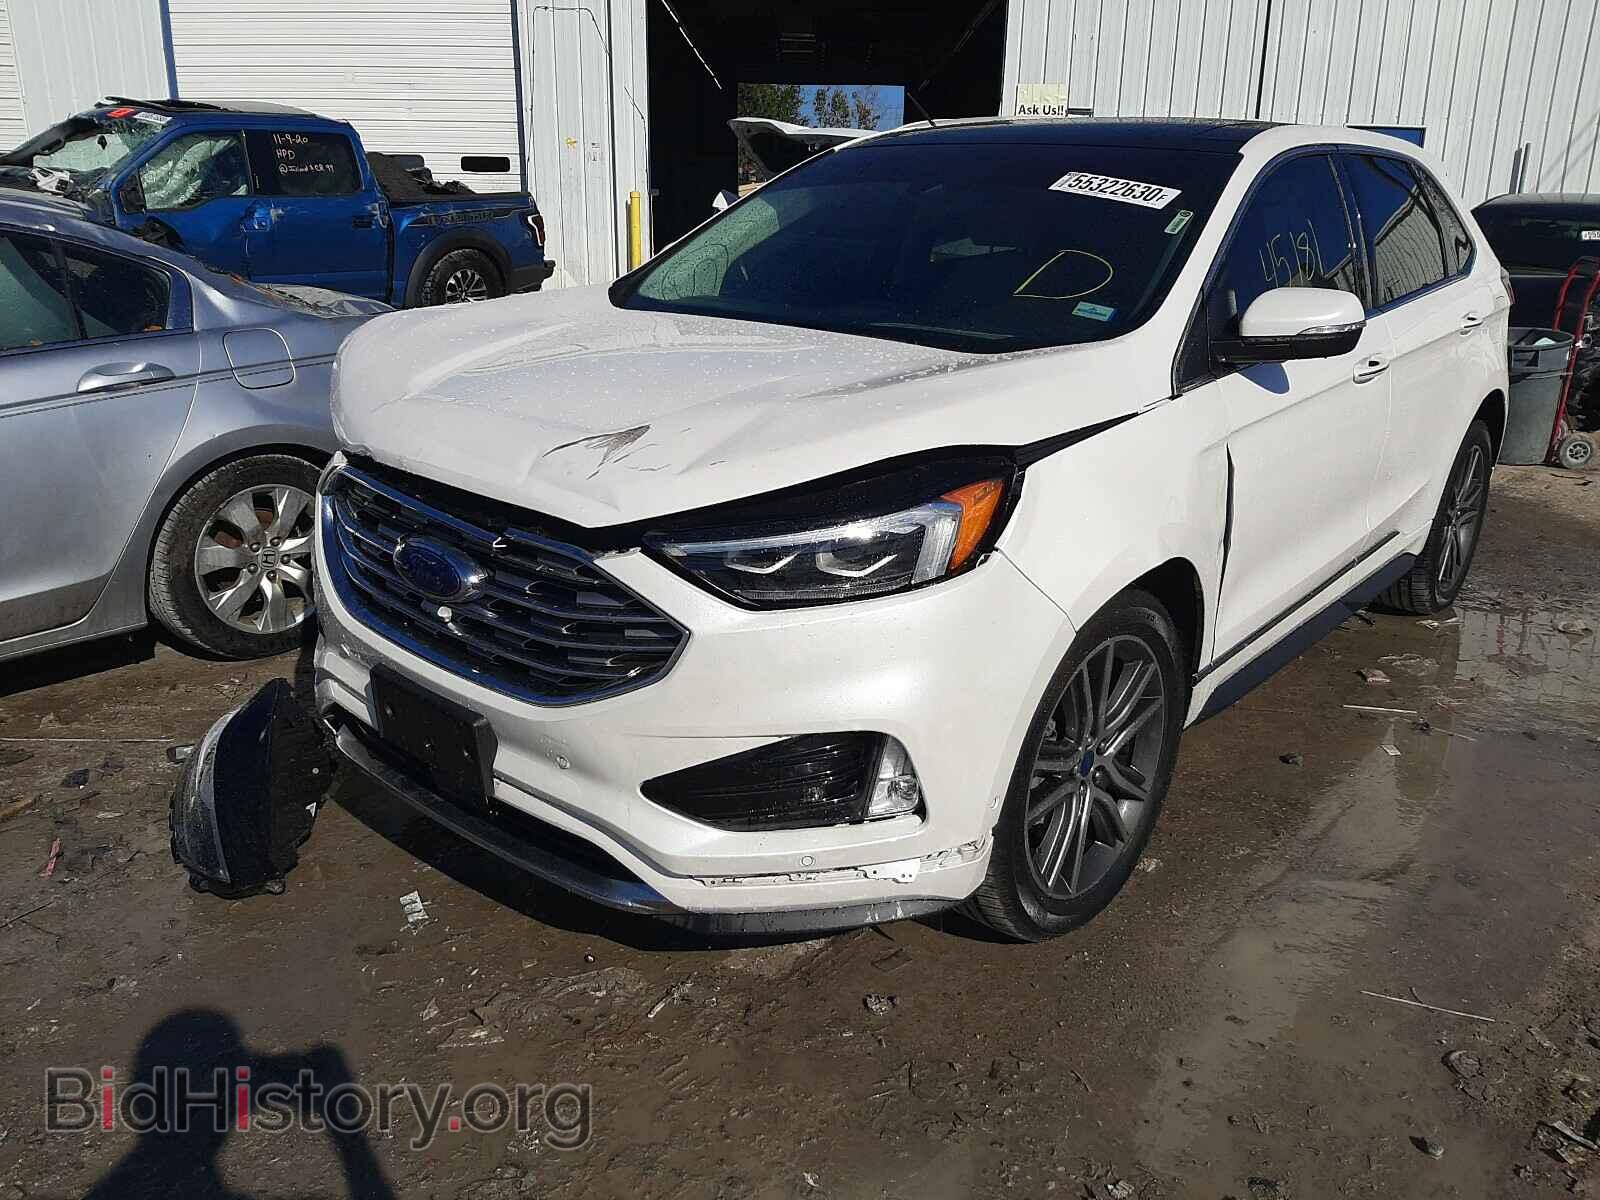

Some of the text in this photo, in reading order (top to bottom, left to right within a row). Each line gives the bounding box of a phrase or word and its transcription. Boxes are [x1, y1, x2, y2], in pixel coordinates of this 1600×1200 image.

[1018, 104, 1064, 116] Ask Us!!
[272, 133, 309, 144] 11-9-20
